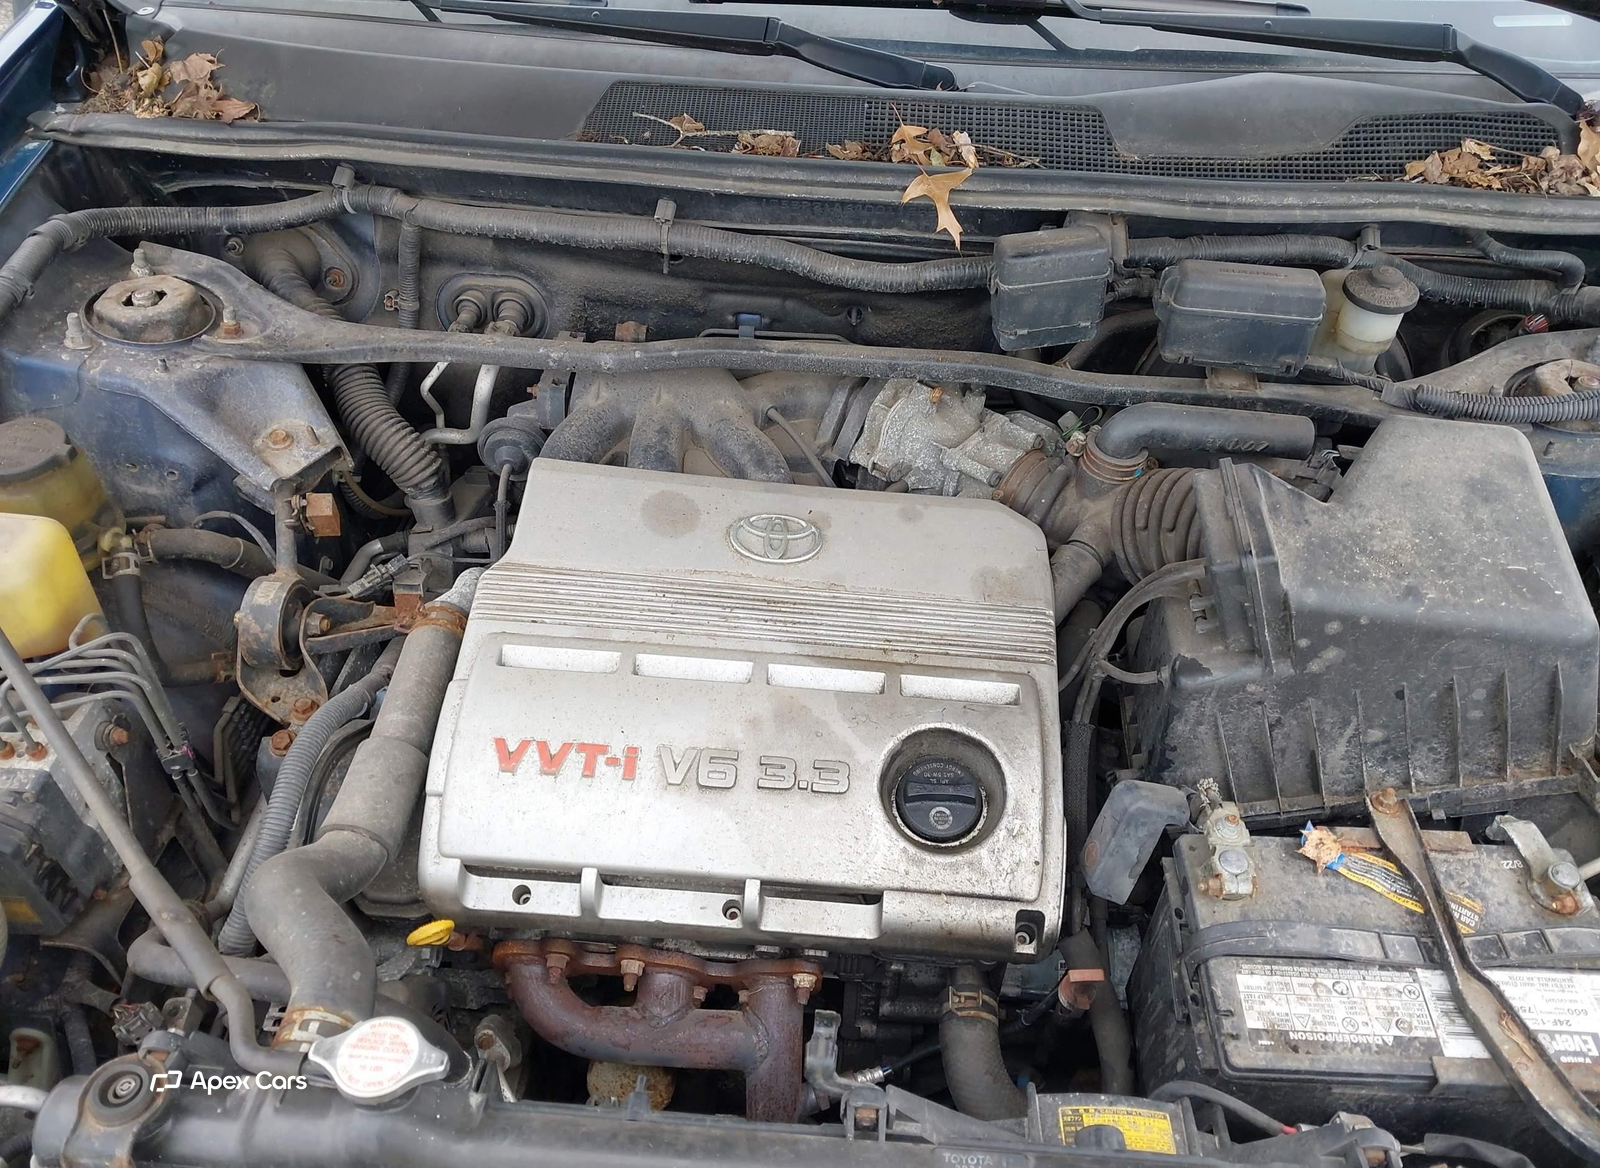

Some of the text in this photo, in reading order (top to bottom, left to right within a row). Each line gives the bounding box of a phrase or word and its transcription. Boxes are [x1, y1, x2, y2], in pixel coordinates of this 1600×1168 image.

[494, 737, 851, 794] VVT-i V6 3.3
[1501, 859, 1524, 870] 8/22
[1460, 915, 1475, 927] CAR
[1567, 1008, 1589, 1017] 600
[370, 1021, 407, 1033] WARNING
[1289, 1031, 1383, 1045] DANGER/POISON
[1538, 1033, 1600, 1057] EverS
[942, 1152, 993, 1166] TOYOTA
